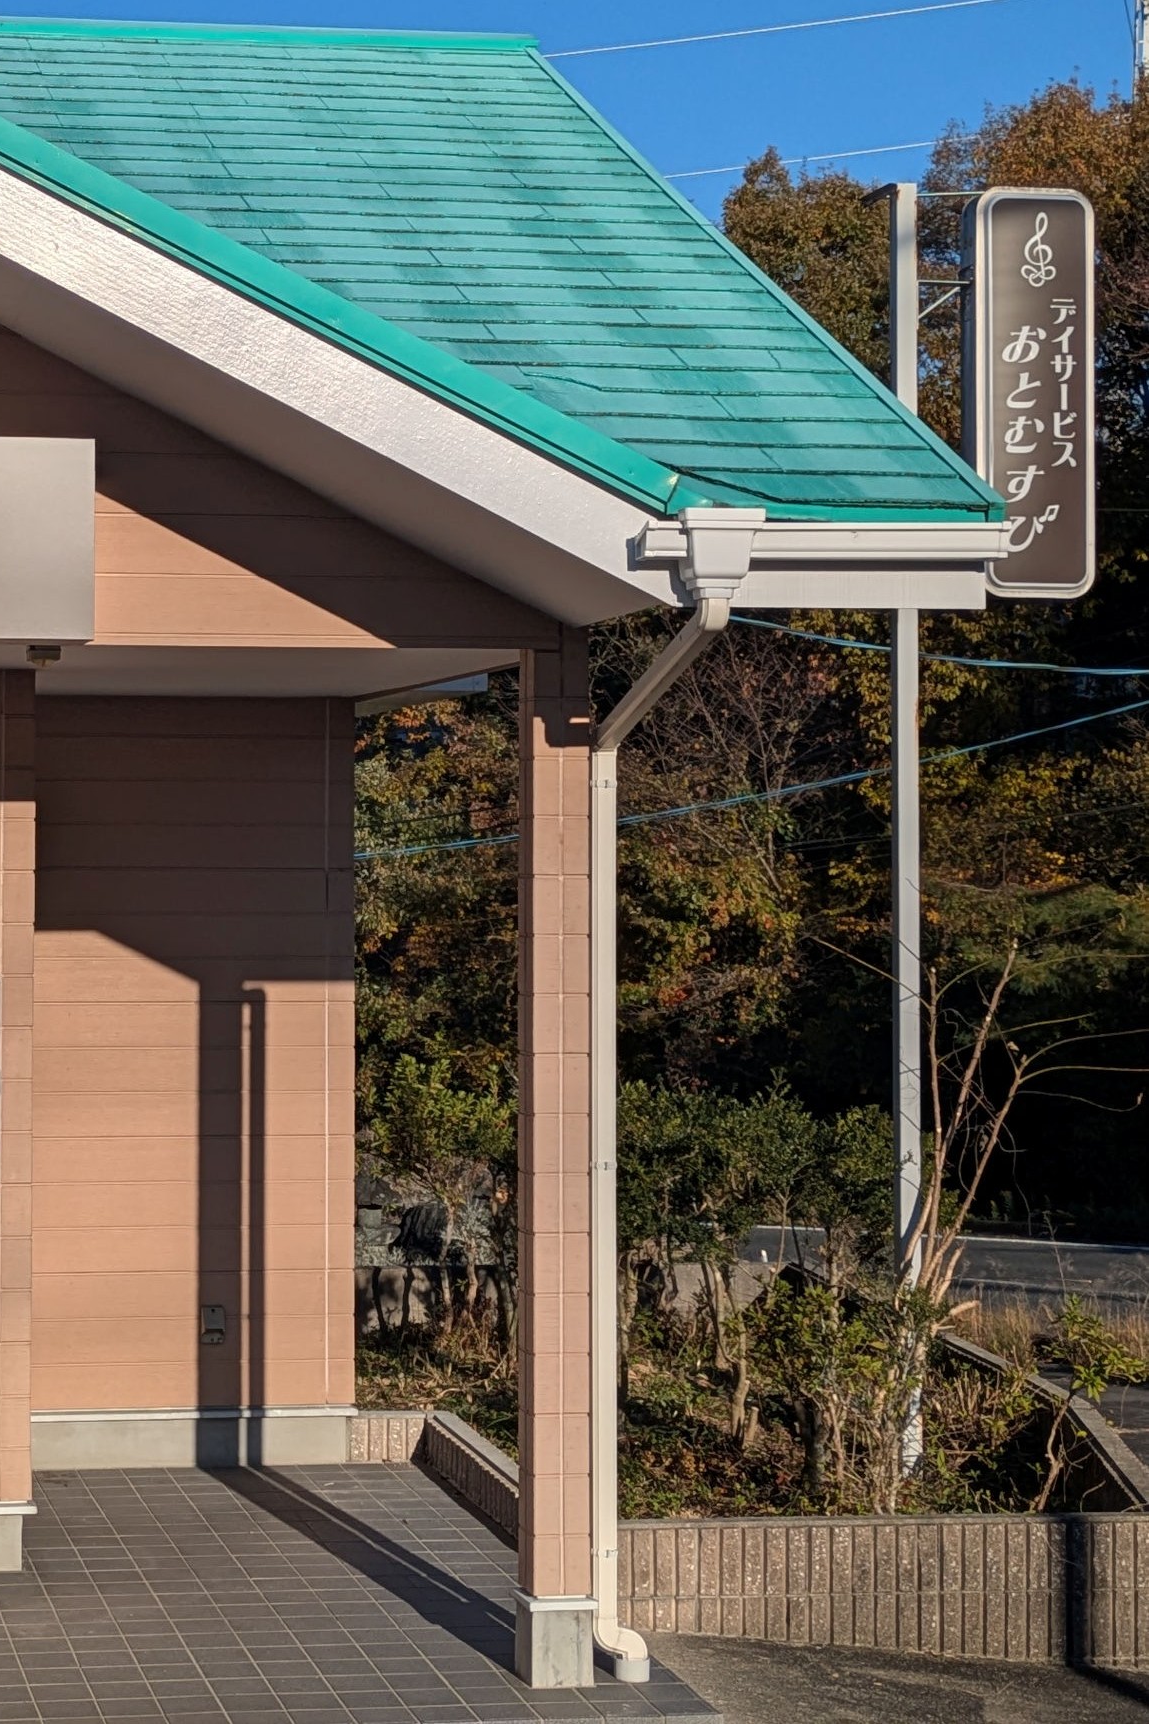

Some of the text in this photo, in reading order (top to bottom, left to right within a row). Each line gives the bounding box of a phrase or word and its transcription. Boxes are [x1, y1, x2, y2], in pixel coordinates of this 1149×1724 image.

[1049, 298, 1078, 467] デイサービス
